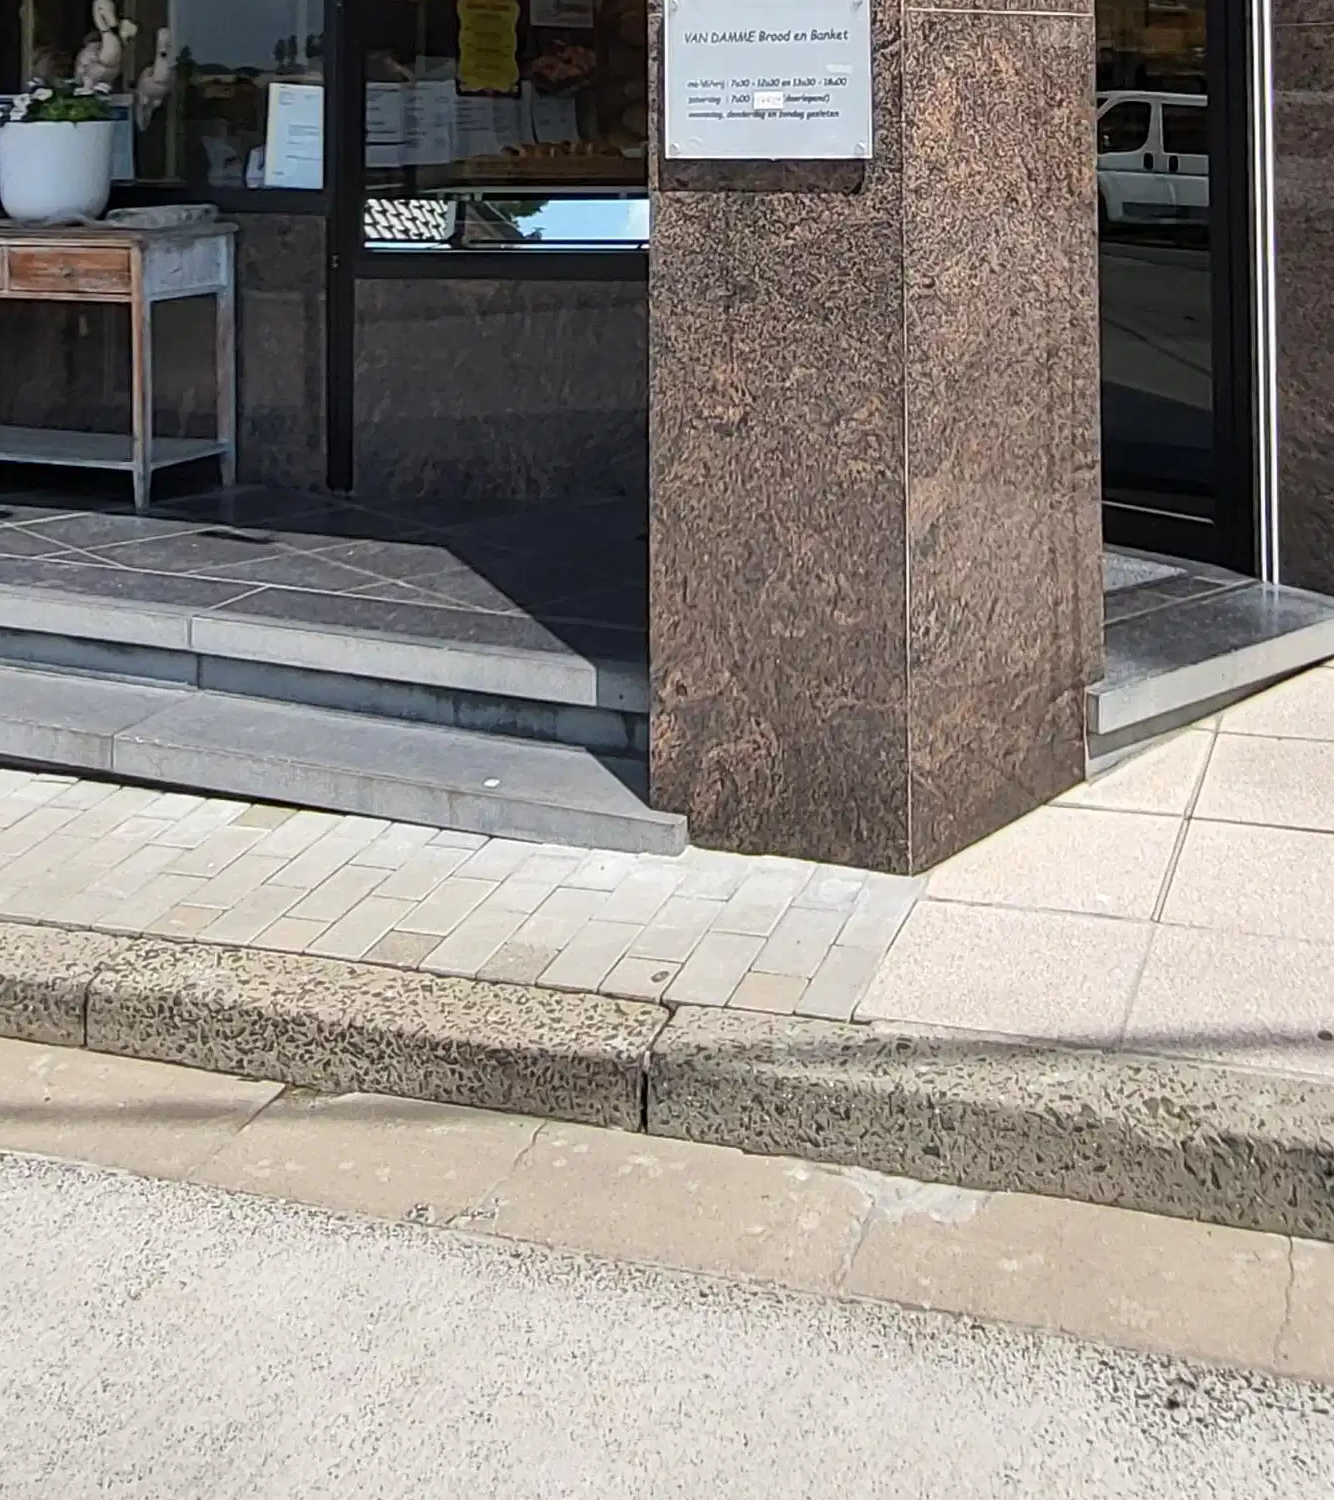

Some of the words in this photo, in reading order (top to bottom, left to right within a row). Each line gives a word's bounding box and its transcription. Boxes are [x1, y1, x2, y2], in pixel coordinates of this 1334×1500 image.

[684, 31, 708, 44] VAN
[711, 30, 756, 44] DAMME
[758, 30, 791, 43] Brood
[793, 32, 807, 42] en
[810, 29, 849, 42] Banket
